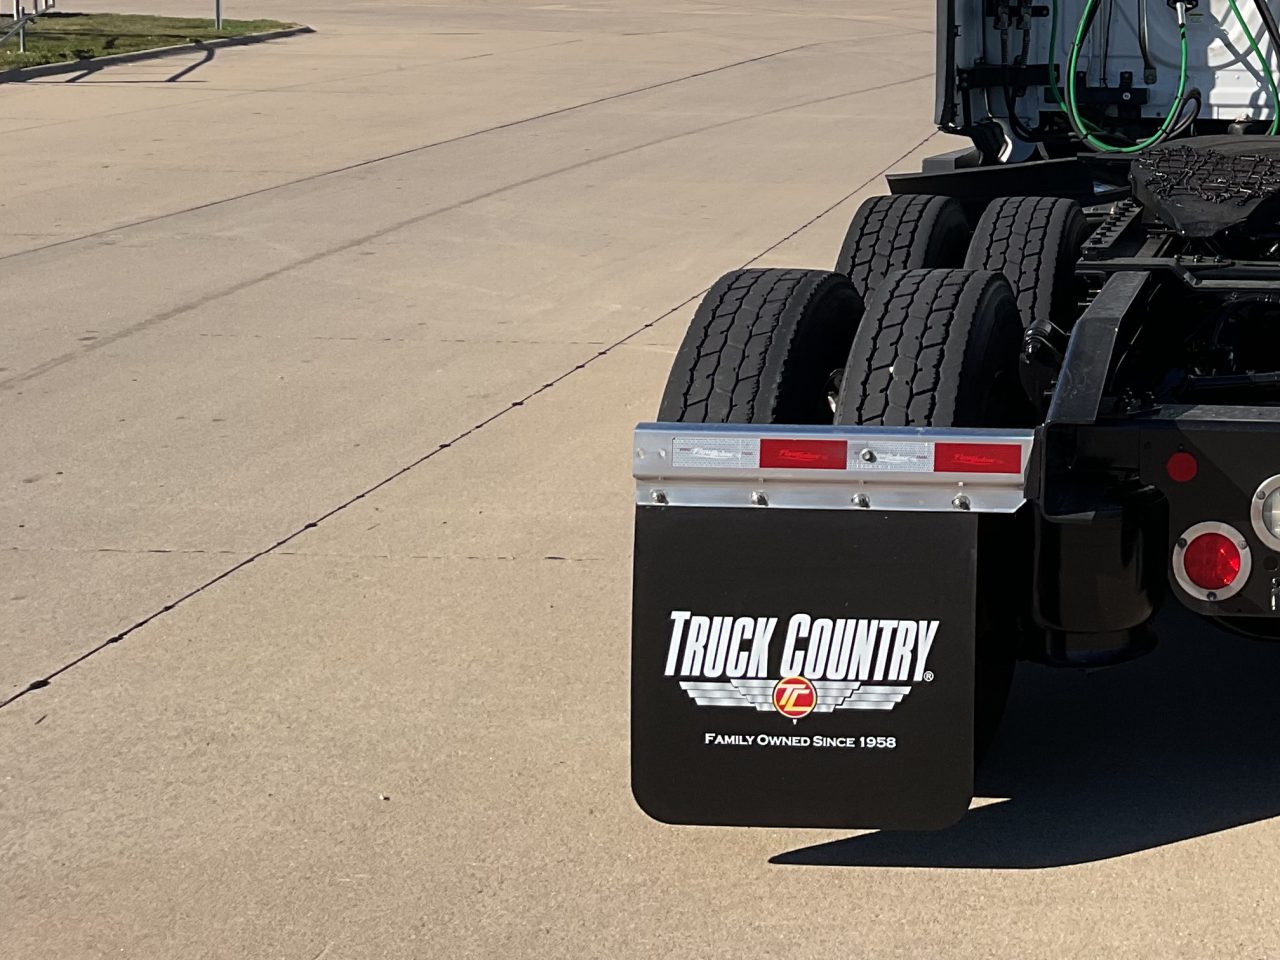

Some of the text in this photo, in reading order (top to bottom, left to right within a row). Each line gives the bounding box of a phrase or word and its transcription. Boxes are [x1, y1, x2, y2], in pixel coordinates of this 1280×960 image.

[664, 610, 778, 678] TRUCK
[705, 732, 897, 748] FAMILY OWNED SINCE 1958
